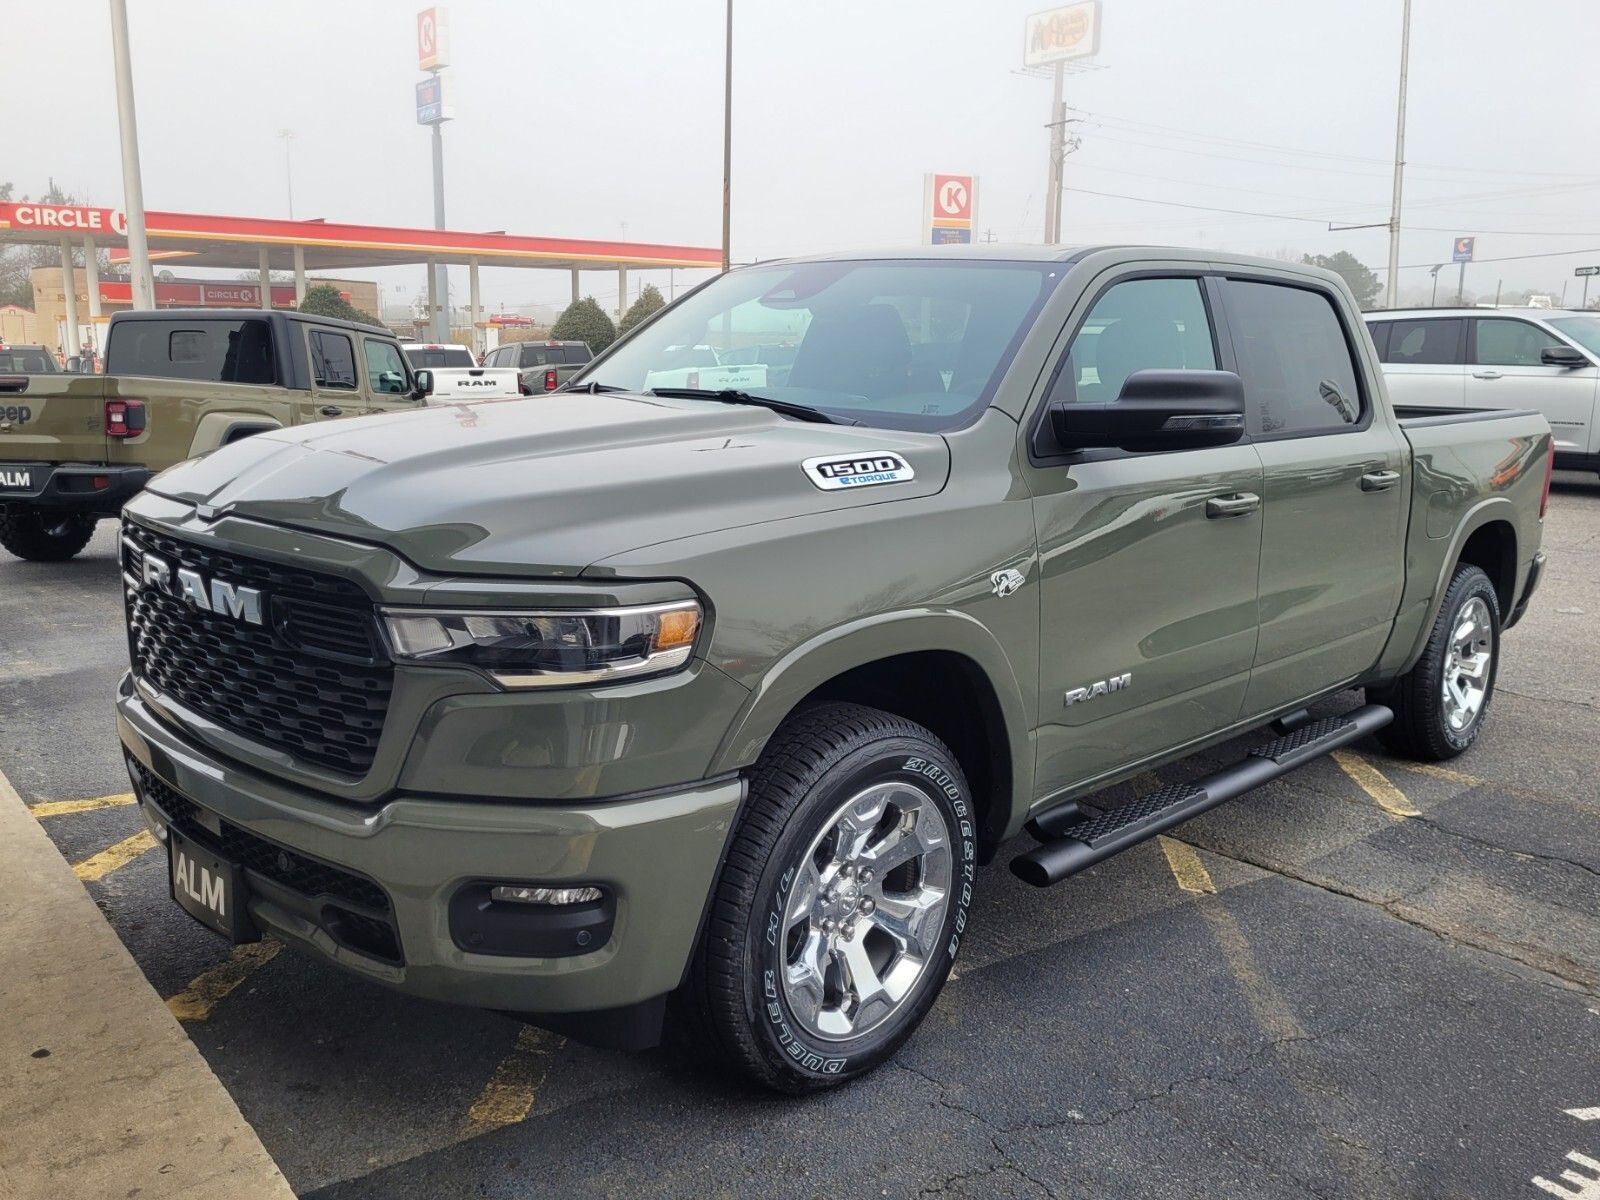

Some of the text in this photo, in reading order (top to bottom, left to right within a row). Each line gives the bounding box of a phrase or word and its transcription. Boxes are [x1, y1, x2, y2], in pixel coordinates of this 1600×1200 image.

[15, 206, 102, 229] CIRCLE
[207, 290, 239, 300] CIRCLE
[821, 459, 895, 477] 1500
[142, 552, 263, 625] RAM
[1063, 672, 1132, 707] RAM
[902, 756, 974, 959] BRIDGESTONE
[176, 852, 225, 917] ALM
[764, 970, 848, 1074] DUELER
